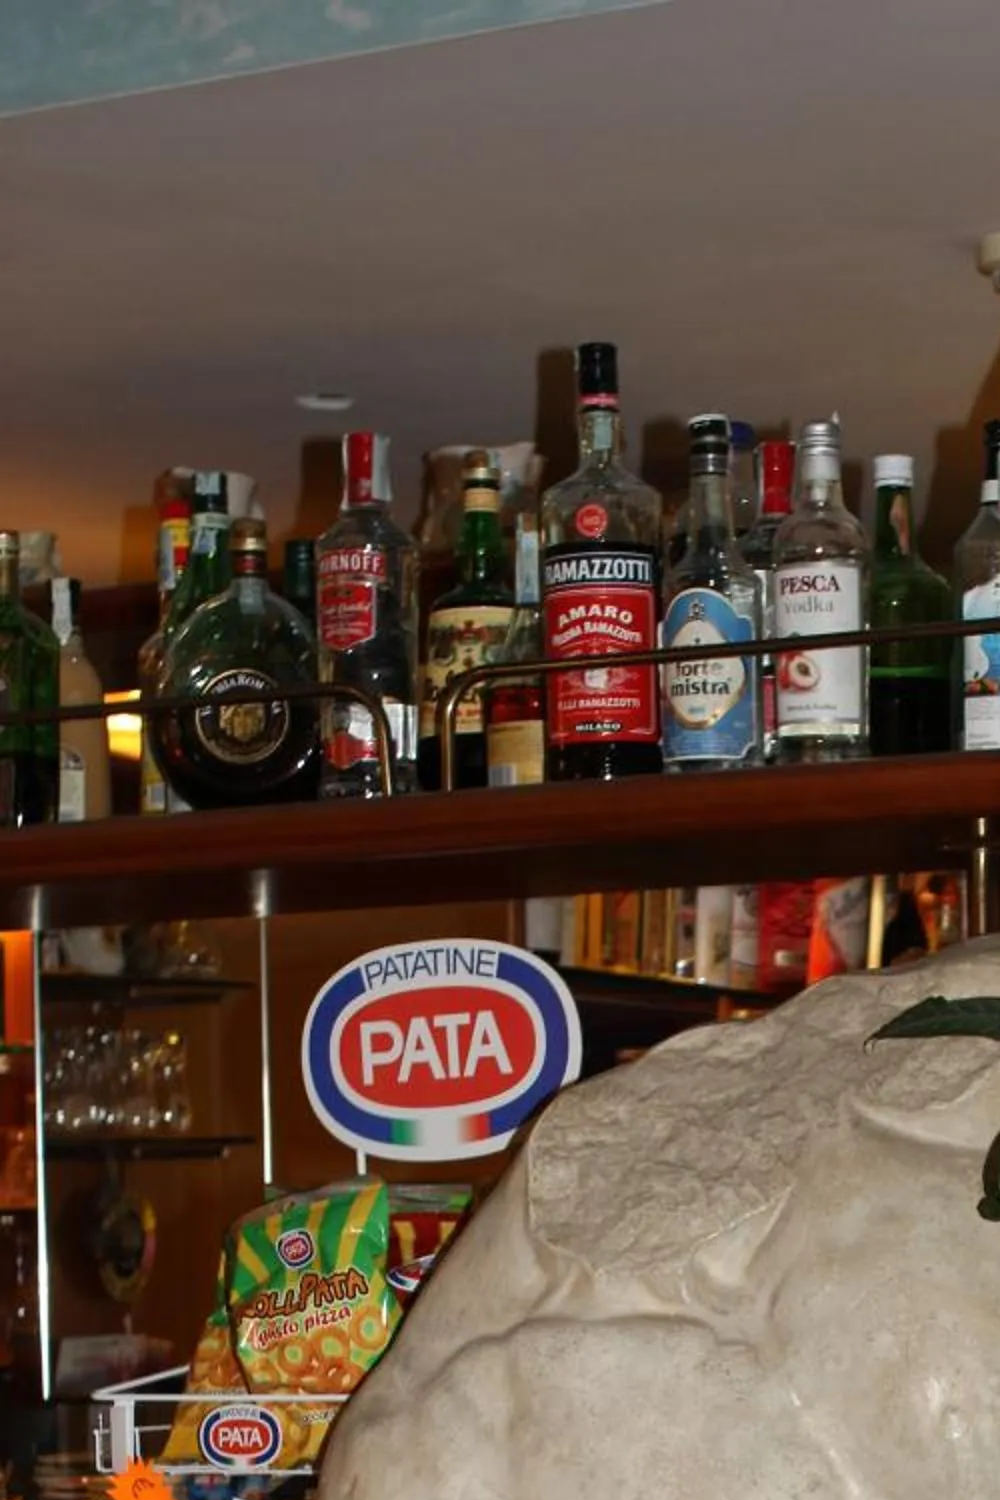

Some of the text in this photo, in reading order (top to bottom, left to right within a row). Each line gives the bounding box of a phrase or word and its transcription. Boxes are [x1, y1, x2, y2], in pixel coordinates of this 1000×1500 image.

[780, 575, 840, 595] PESCA
[559, 604, 633, 628] AMARO
[363, 948, 498, 991] PATATINE
[359, 1009, 513, 1087] PATA
[303, 1306, 351, 1335] pizza
[218, 1426, 263, 1449] PATA
